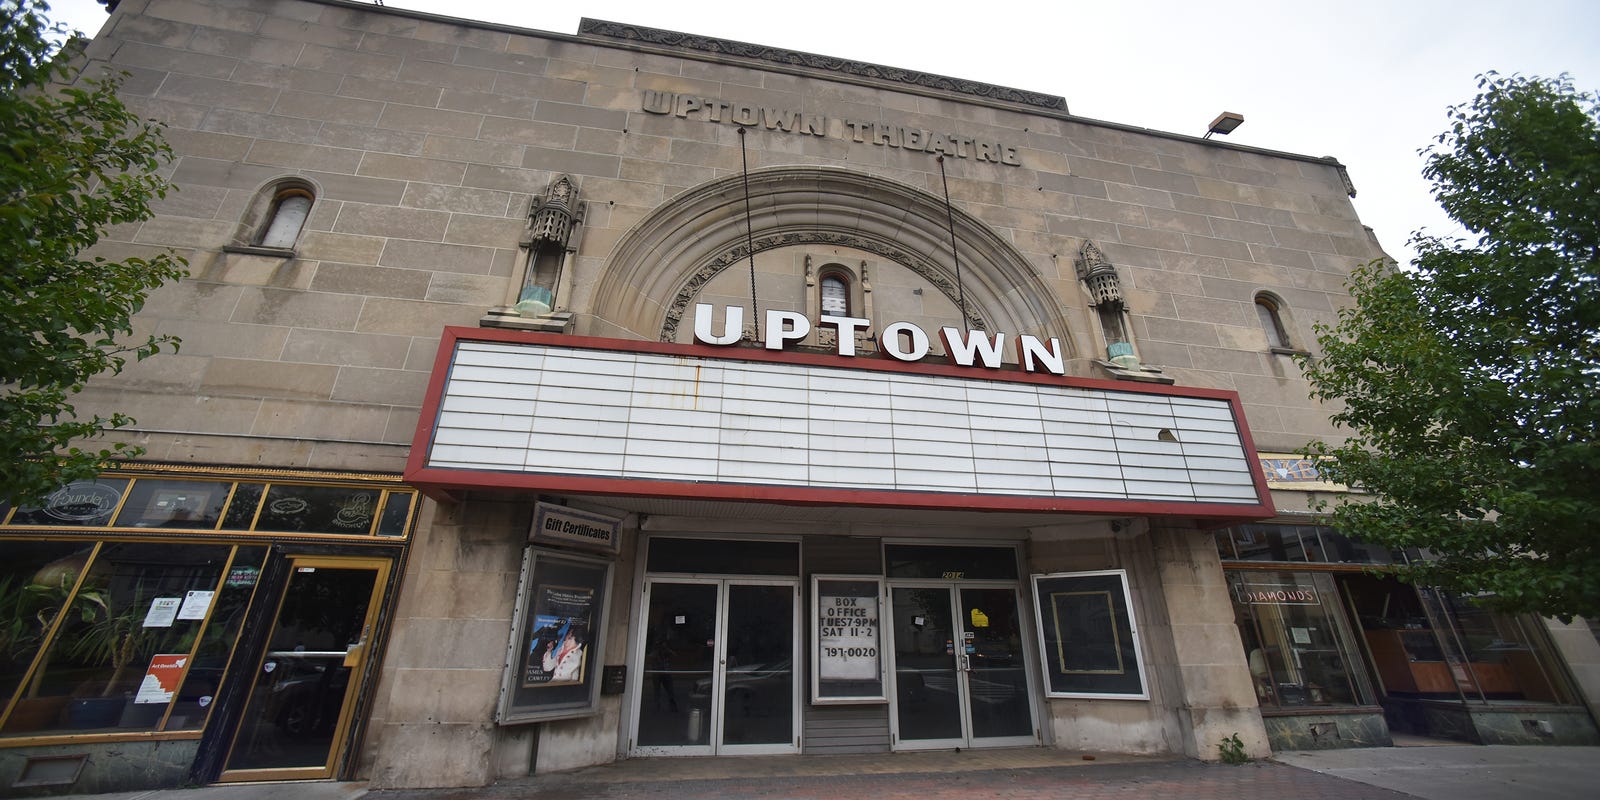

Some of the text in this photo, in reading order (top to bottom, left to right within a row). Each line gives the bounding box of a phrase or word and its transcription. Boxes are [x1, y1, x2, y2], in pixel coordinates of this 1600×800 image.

[641, 89, 1021, 167] UPTOWN THEATRE
[692, 302, 1065, 375] UPTOWN
[545, 517, 610, 540] Gift Certificates
[835, 597, 857, 607] BOX
[827, 608, 867, 617] OFFICE
[822, 627, 844, 637] SAT
